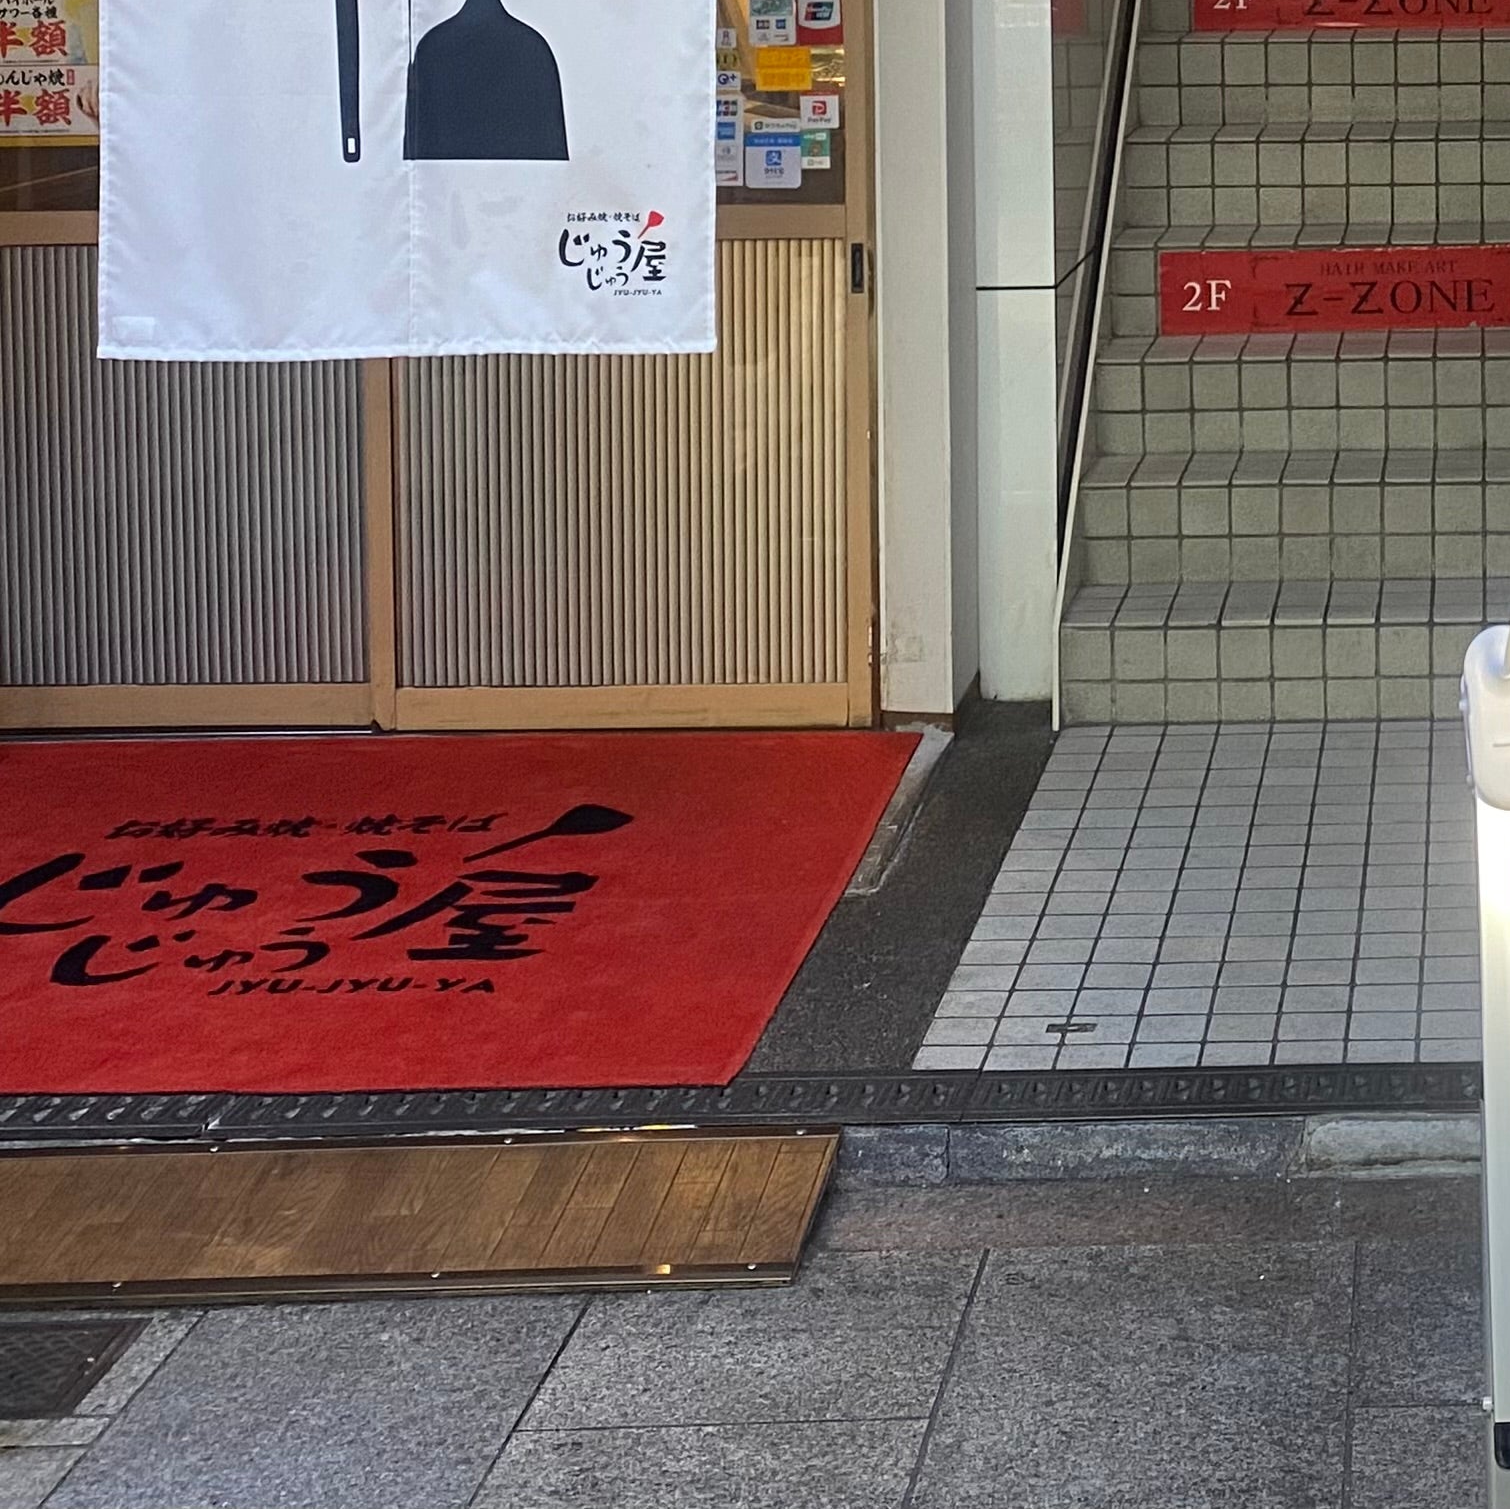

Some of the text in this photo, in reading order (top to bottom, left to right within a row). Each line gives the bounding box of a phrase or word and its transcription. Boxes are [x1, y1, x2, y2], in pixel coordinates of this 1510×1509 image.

[1425, 260, 1457, 274] ART
[1182, 280, 1232, 311] 2F
[1285, 278, 1495, 316] Z-ZONE
[208, 977, 496, 995] JYU-JYU-YA
